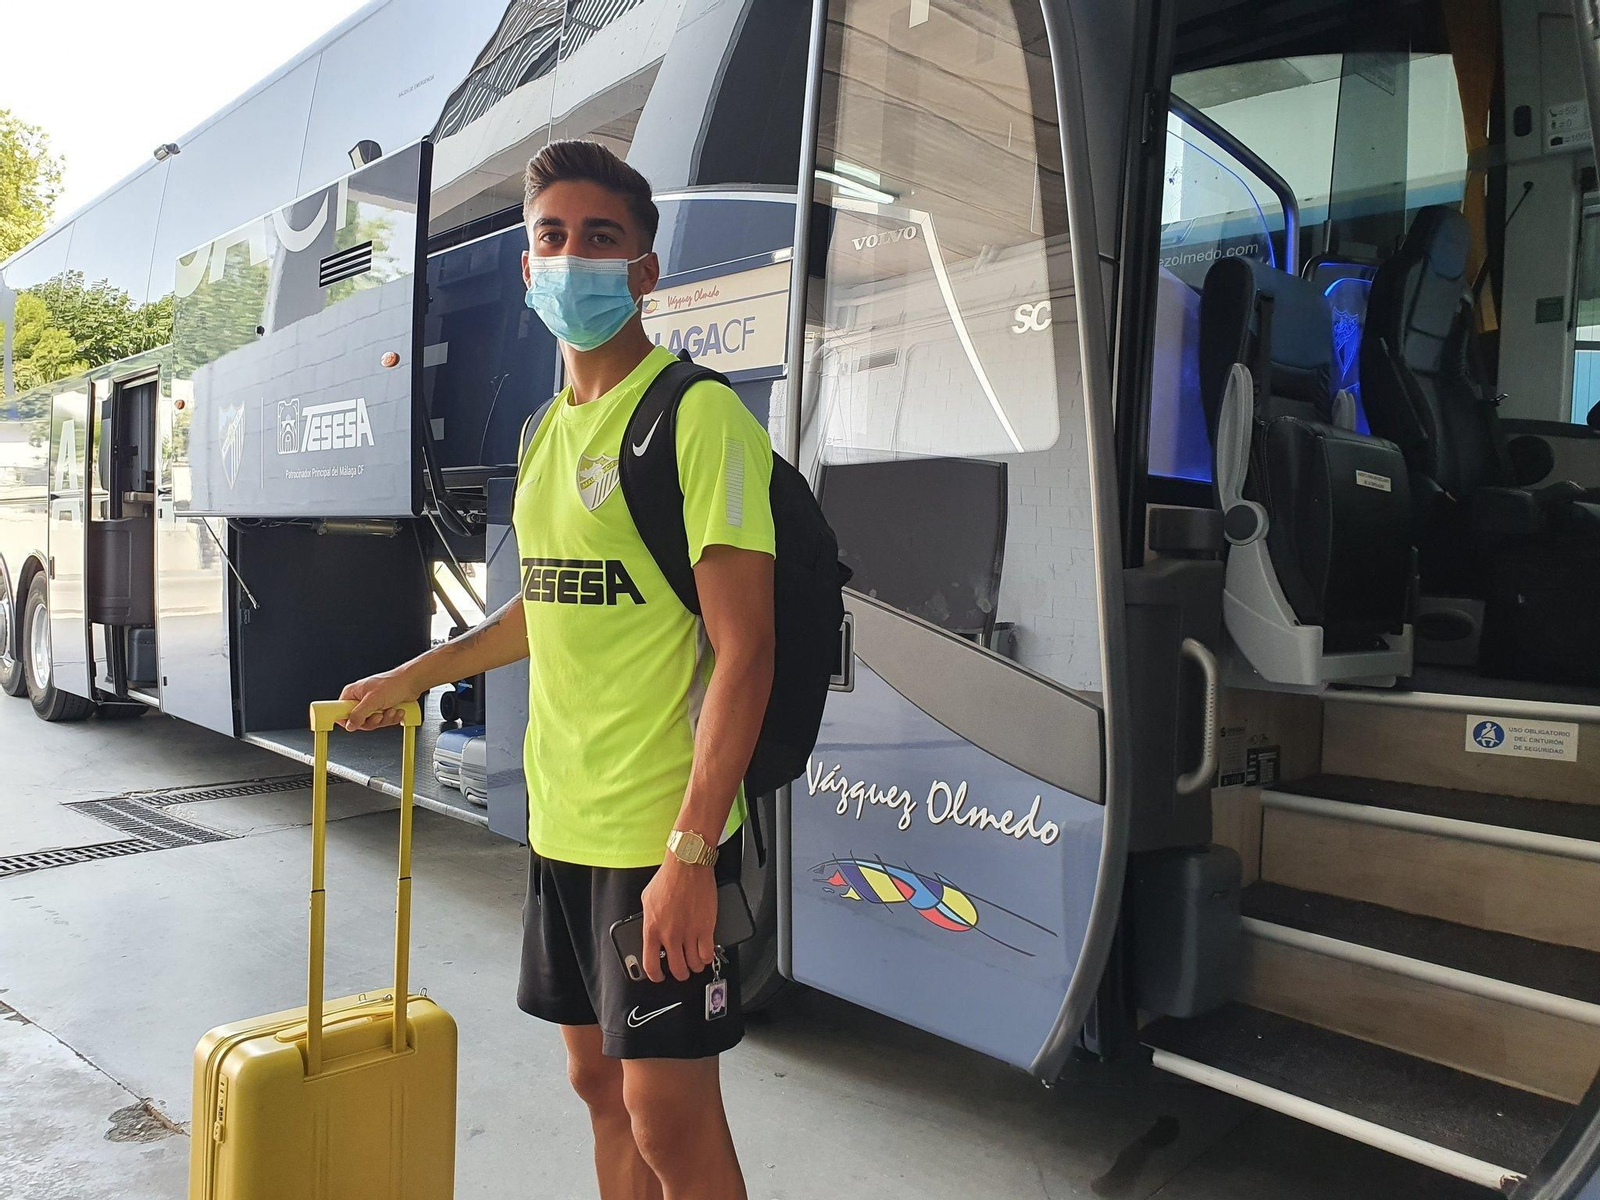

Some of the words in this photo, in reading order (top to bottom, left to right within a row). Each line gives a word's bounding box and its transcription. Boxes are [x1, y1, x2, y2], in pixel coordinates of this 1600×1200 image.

[851, 226, 917, 251] VOLVO
[301, 397, 375, 453] TESESA
[358, 464, 364, 475] CF
[522, 558, 647, 606] TESESA
[1524, 728, 1570, 737] OBLIGATORIO
[1524, 746, 1564, 754] SEGURIDAD
[805, 753, 917, 831] Vázquez
[925, 779, 1061, 846] Olmedo
